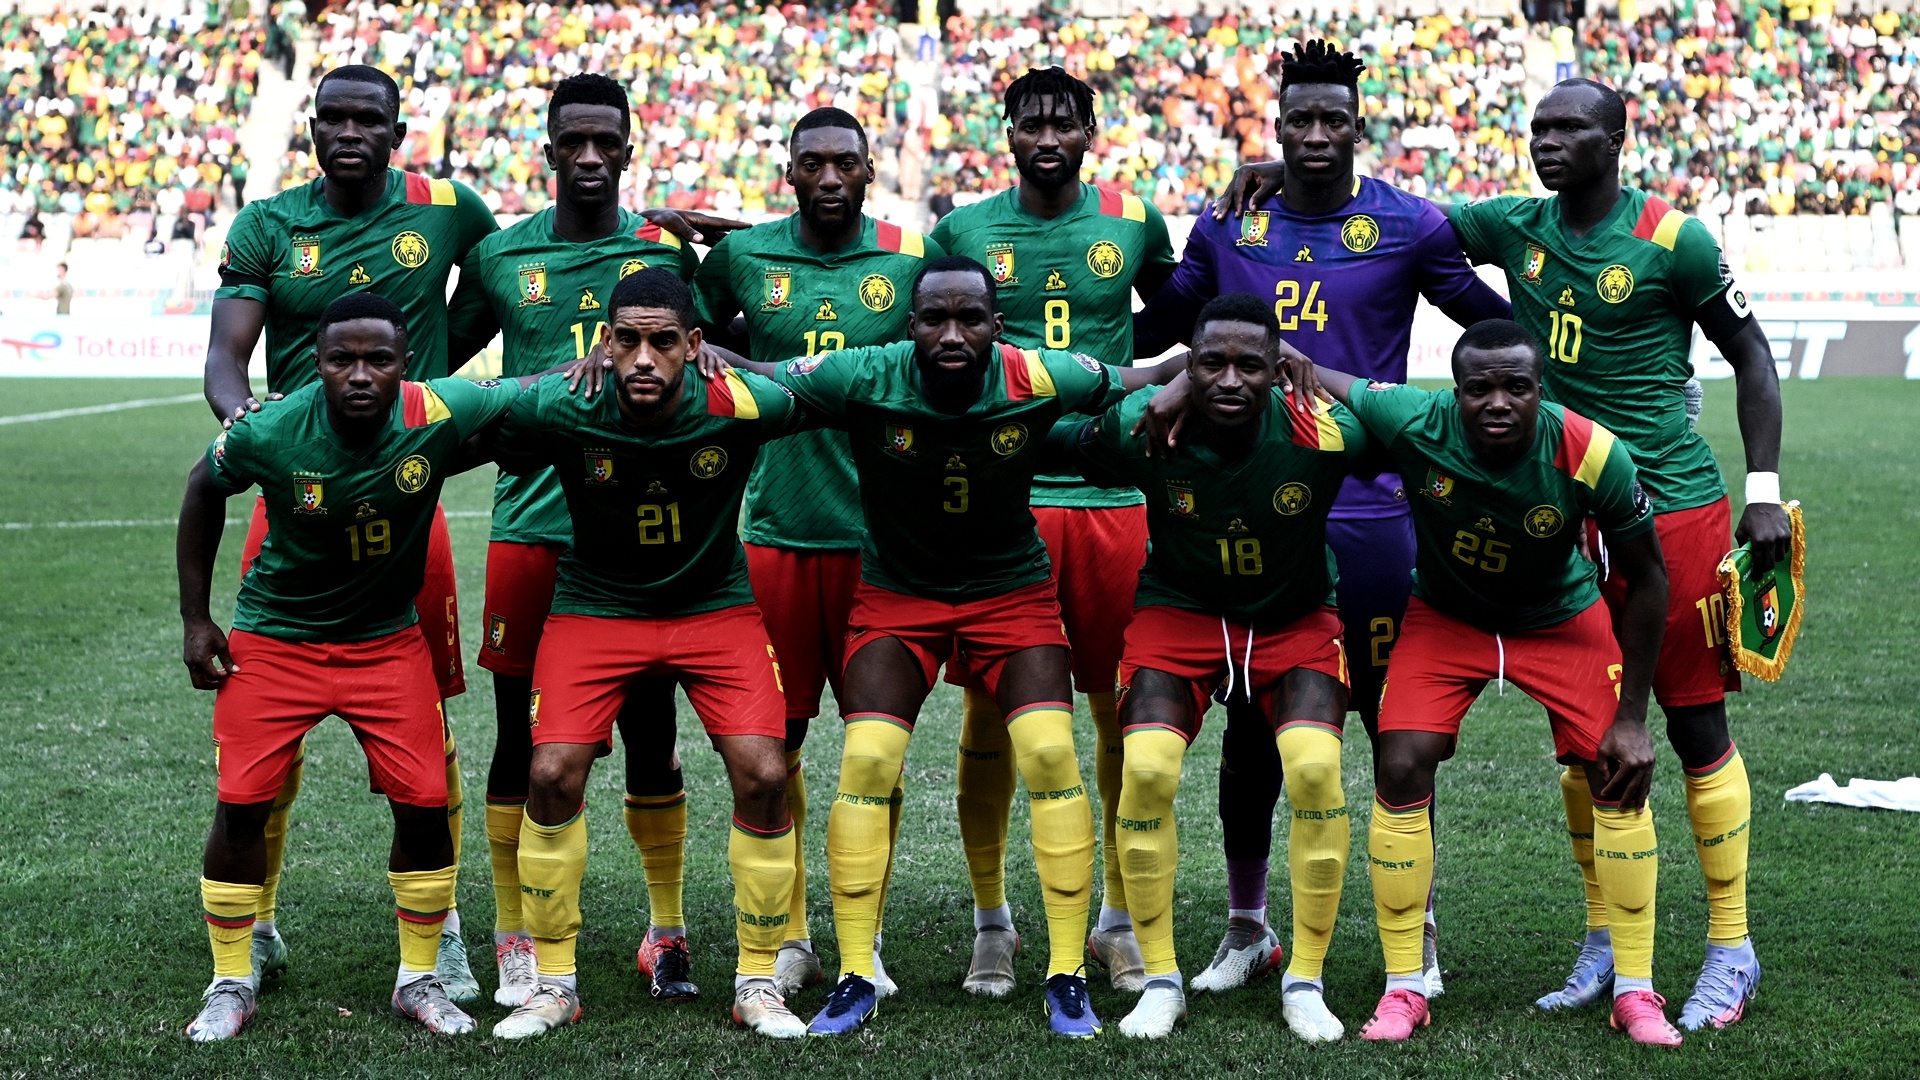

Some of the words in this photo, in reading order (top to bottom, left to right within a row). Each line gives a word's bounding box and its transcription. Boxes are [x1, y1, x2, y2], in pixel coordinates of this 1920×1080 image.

[1044, 299, 1070, 349] 8
[1275, 280, 1329, 332] 24
[1549, 310, 1583, 364] 10
[943, 476, 969, 513] 3
[345, 518, 391, 561] 19
[637, 502, 682, 545] 21
[1215, 537, 1263, 576] 18
[1451, 529, 1512, 573] 25
[445, 596, 455, 645] 5
[1370, 616, 1394, 667] 2
[1695, 592, 1726, 648] 10
[1121, 817, 1162, 831] SPORTIF
[1296, 809, 1303, 819] LE
[1304, 810, 1324, 820] COQ
[1607, 850, 1628, 859] COQ
[1704, 834, 1725, 847] COQ
[741, 911, 757, 926] COQ
